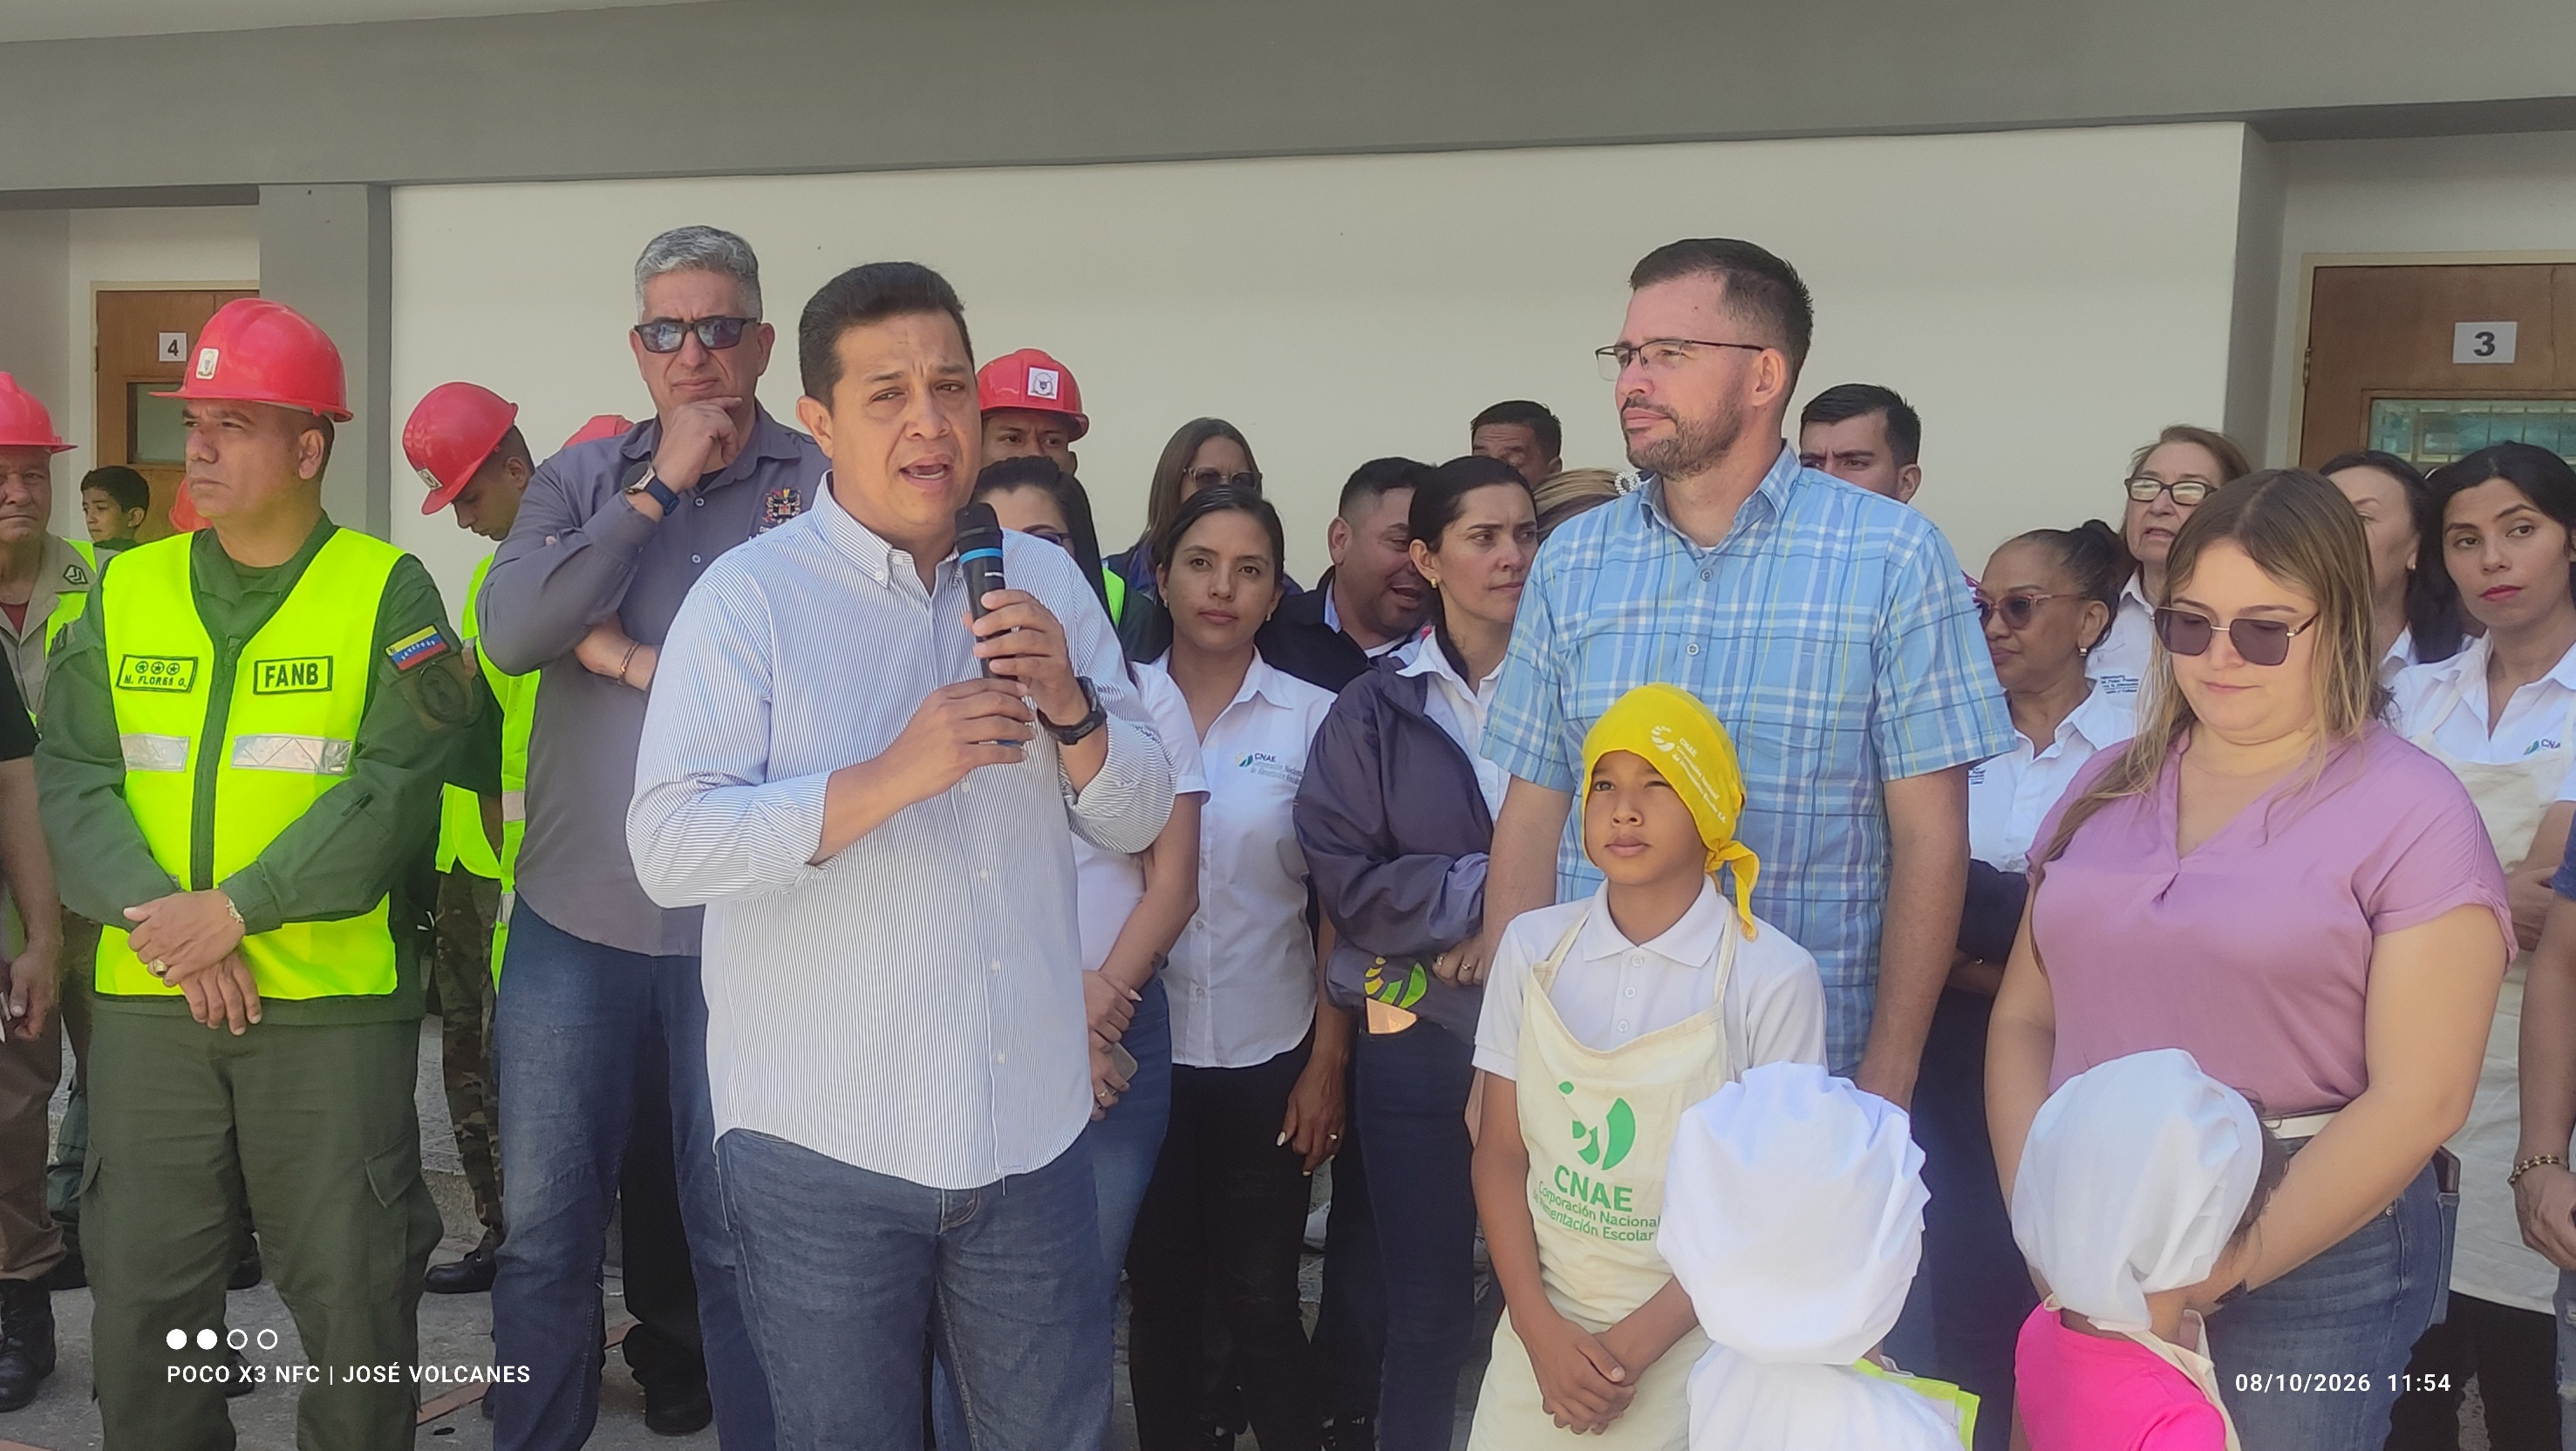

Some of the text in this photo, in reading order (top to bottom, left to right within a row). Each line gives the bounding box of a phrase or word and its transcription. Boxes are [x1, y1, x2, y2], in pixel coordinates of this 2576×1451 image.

[167, 339, 179, 357] 4
[2473, 331, 2496, 357] 3
[264, 663, 318, 688] FANB
[1254, 753, 1277, 763] CNAE
[1554, 1164, 1632, 1213] CNAE
[1539, 1181, 1660, 1227] Corporación Nacional
[1603, 1226, 1654, 1241] Escolar
